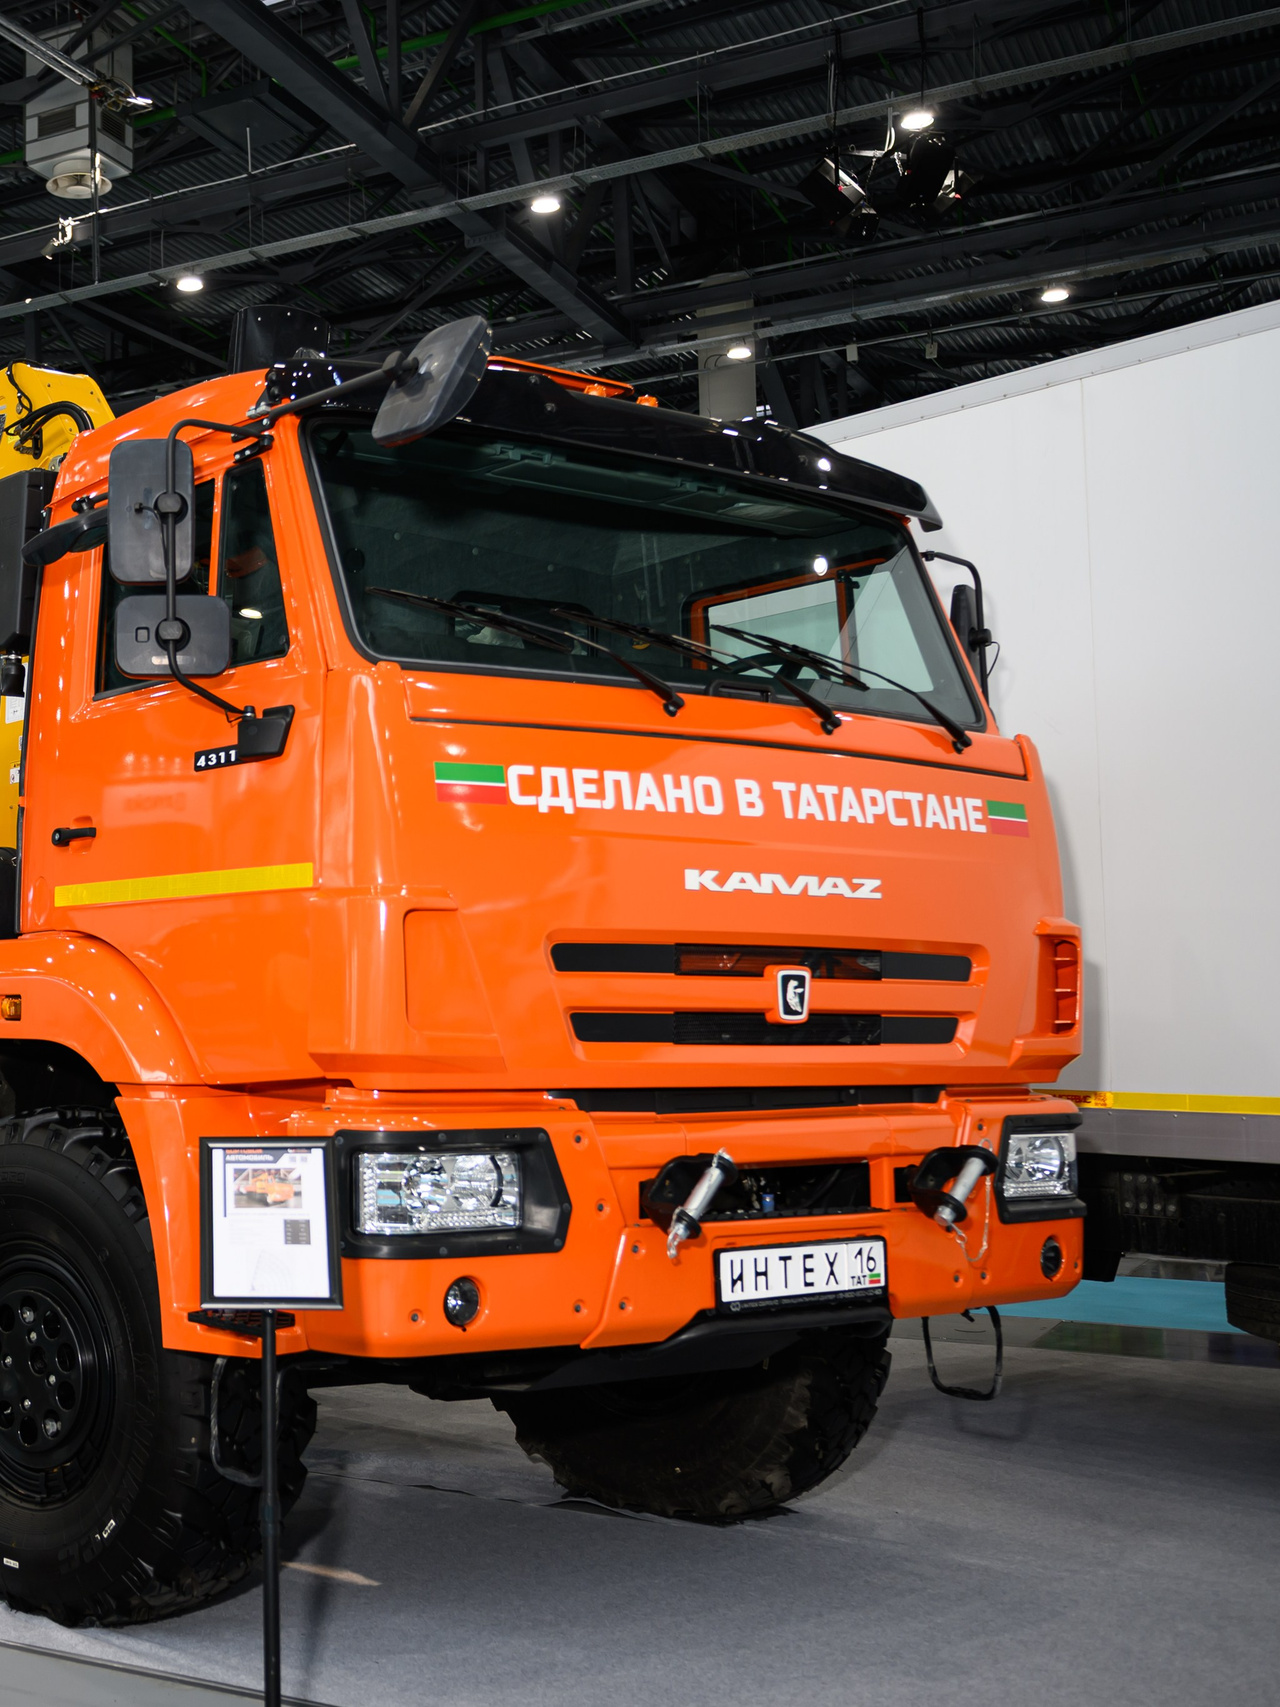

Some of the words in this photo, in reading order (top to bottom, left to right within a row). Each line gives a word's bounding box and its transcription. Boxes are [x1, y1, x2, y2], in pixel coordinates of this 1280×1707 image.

[196, 749, 237, 767] 4311
[507, 764, 723, 816] СДЕЛАНО
[738, 778, 765, 817] В
[773, 781, 987, 833] ТАТАРСТАНЕ
[684, 869, 883, 899] KAMAZ
[730, 1252, 839, 1293] ИНТЕХ
[854, 1246, 877, 1273] 16
[850, 1274, 867, 1286] ТАТ
